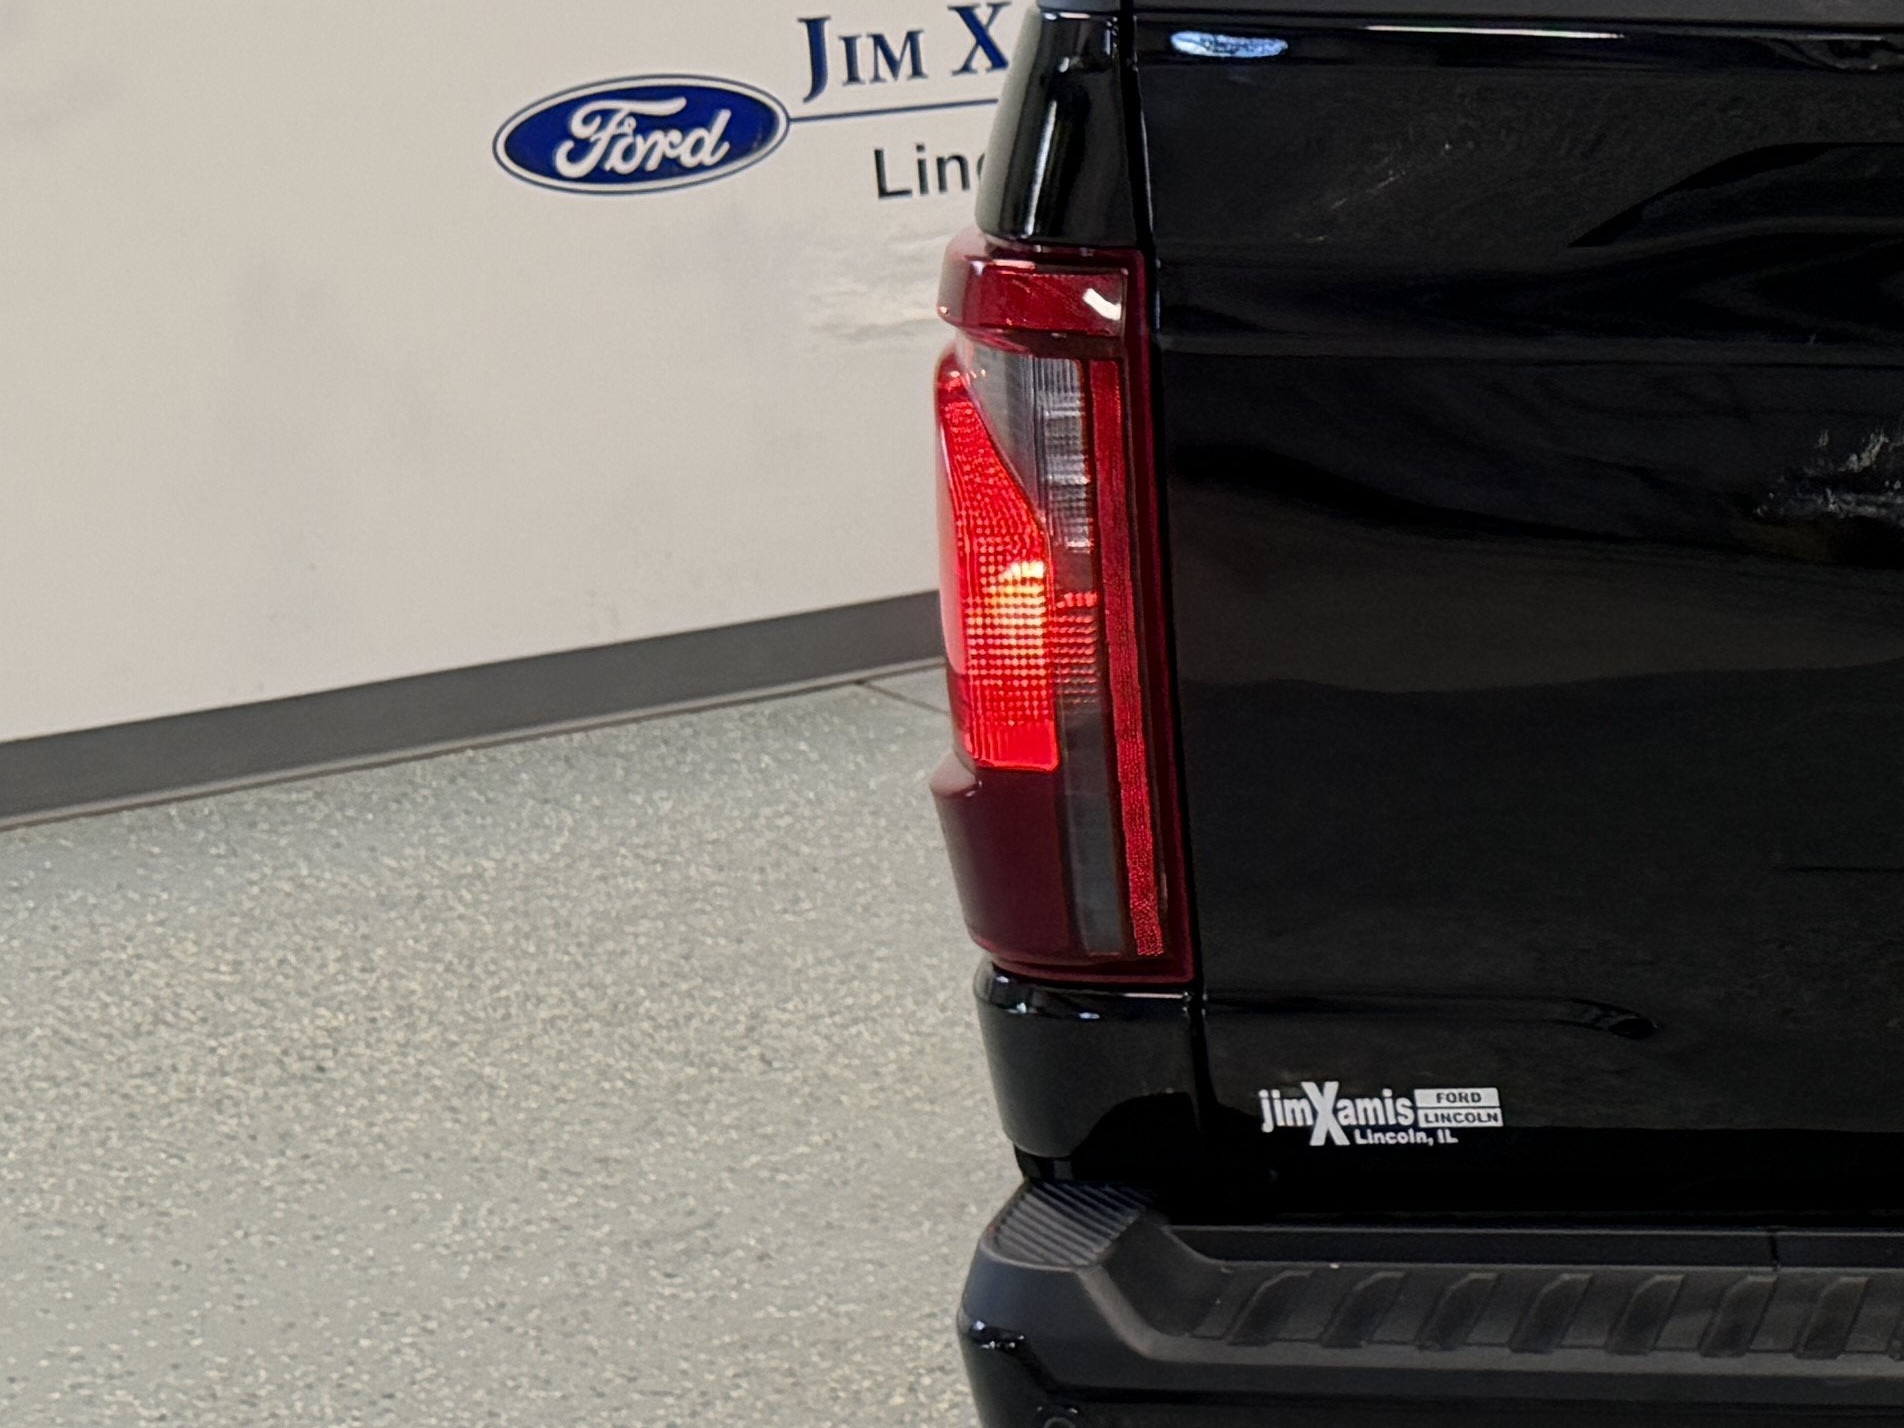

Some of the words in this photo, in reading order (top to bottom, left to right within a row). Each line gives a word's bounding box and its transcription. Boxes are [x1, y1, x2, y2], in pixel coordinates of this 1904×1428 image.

[797, 16, 928, 103] JIM
[554, 95, 733, 179] Ford
[1436, 1092, 1482, 1104] FORD
[1424, 1111, 1499, 1124] LINCOLN
[1354, 1128, 1434, 1146] Lincoln,
[1438, 1130, 1459, 1144] IL
